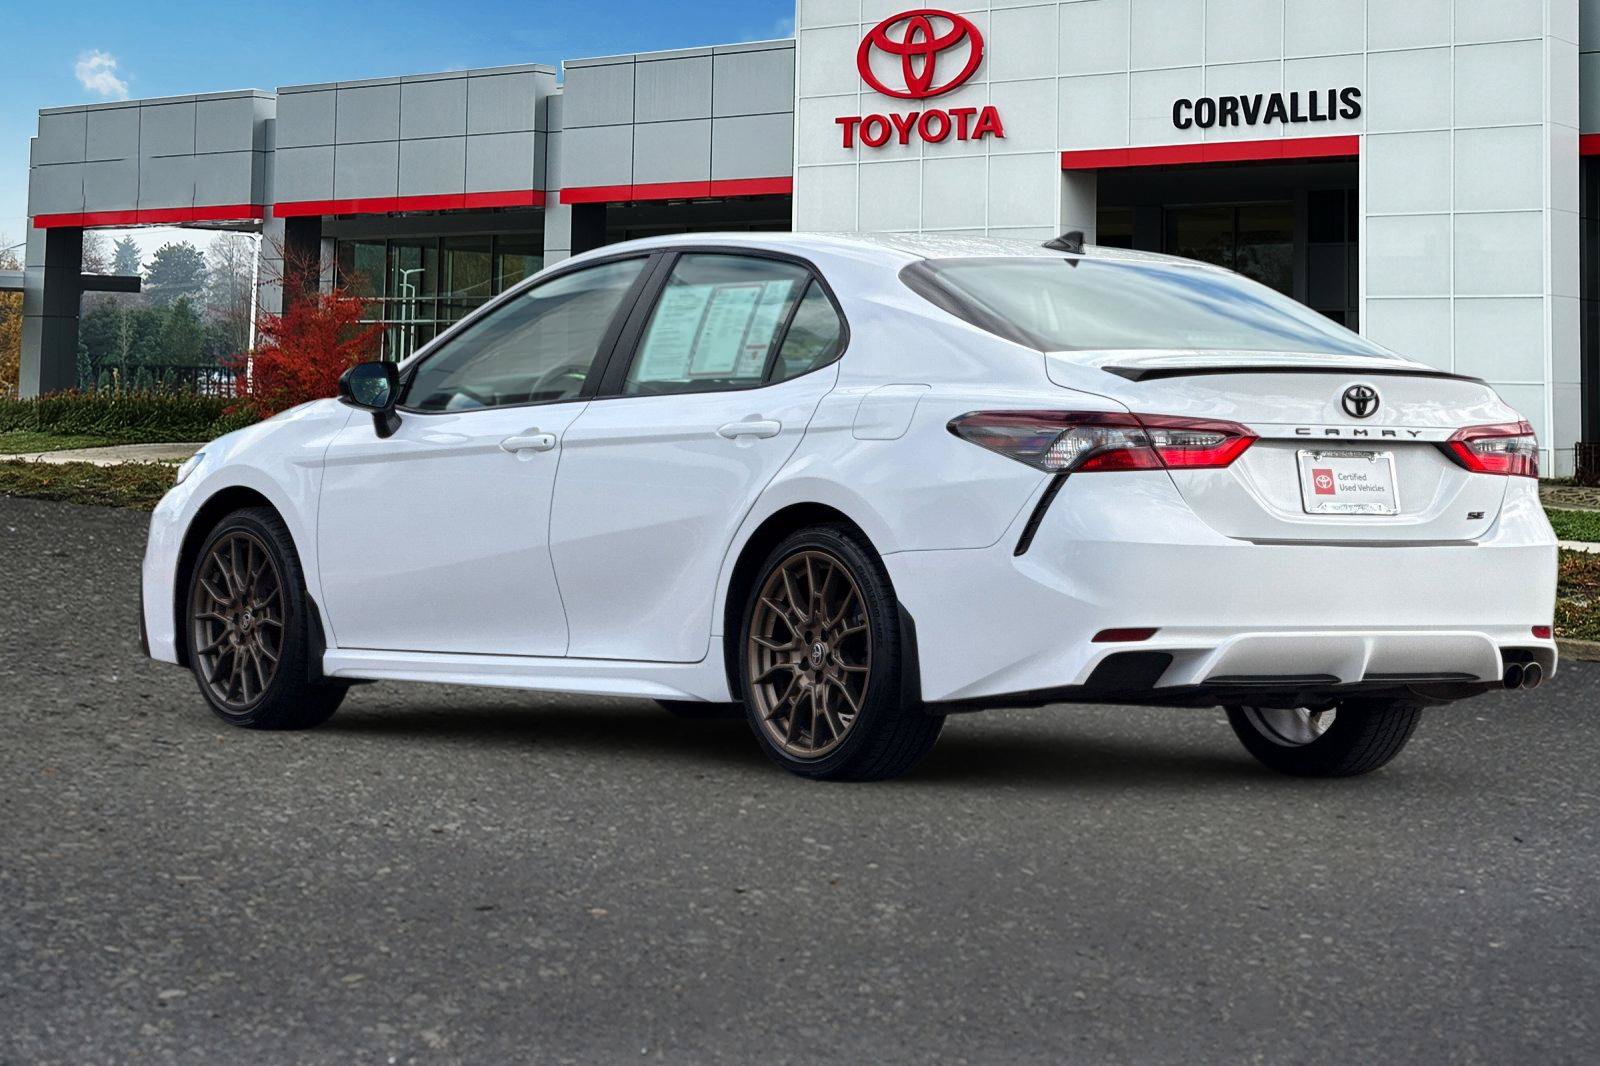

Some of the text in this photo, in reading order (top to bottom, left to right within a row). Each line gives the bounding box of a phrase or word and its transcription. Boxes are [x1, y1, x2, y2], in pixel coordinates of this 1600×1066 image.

[1172, 87, 1362, 129] CORVALLIS
[835, 106, 1006, 149] TOYOTA
[1295, 427, 1422, 438] CAMRY
[1337, 472, 1367, 481] Certified
[1339, 483, 1385, 492] Used Vehicles
[1466, 511, 1485, 521] SE
